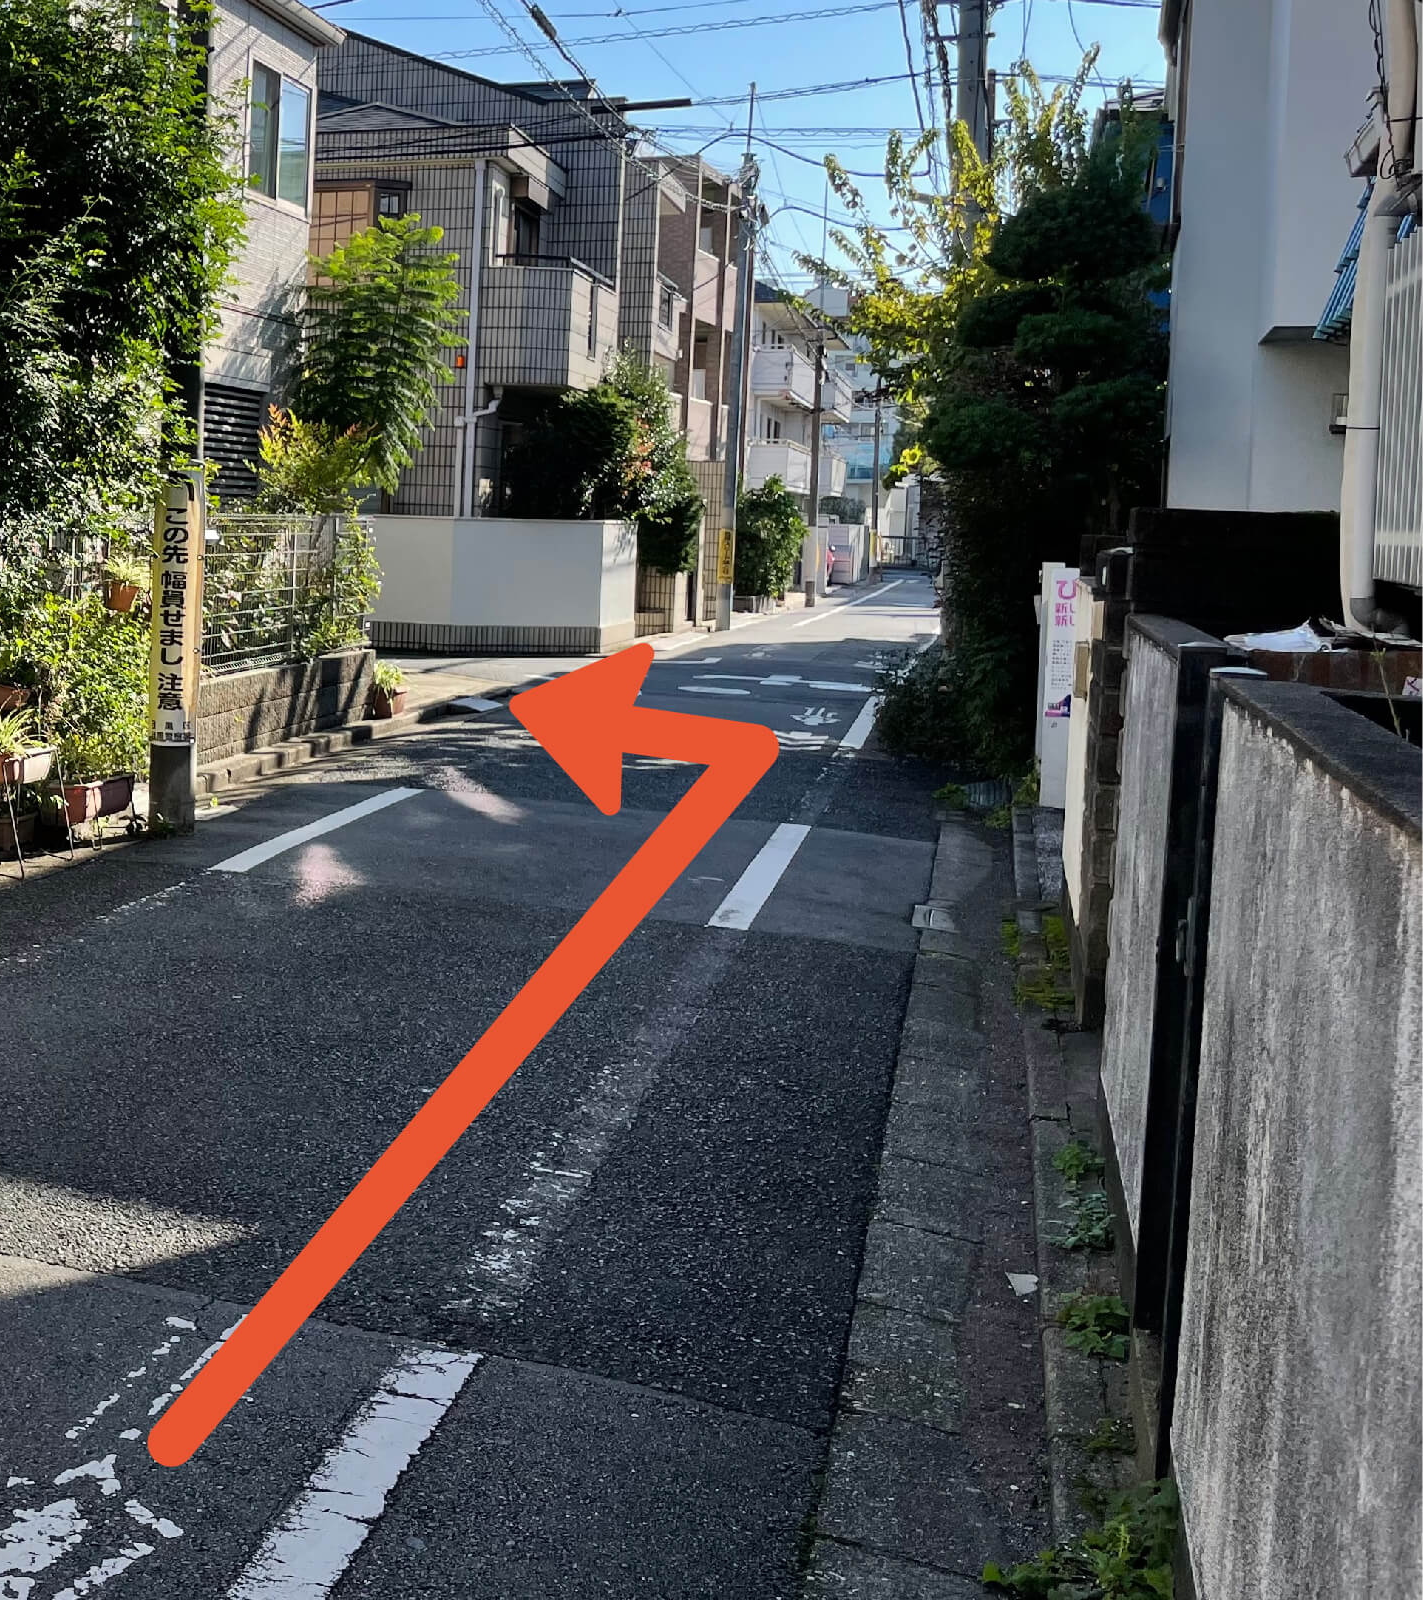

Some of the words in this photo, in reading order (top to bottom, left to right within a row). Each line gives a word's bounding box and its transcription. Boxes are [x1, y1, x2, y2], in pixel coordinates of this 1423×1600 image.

[161, 507, 189, 565] この先
[159, 570, 187, 666] 幅員せまし
[157, 672, 184, 711] 注意
